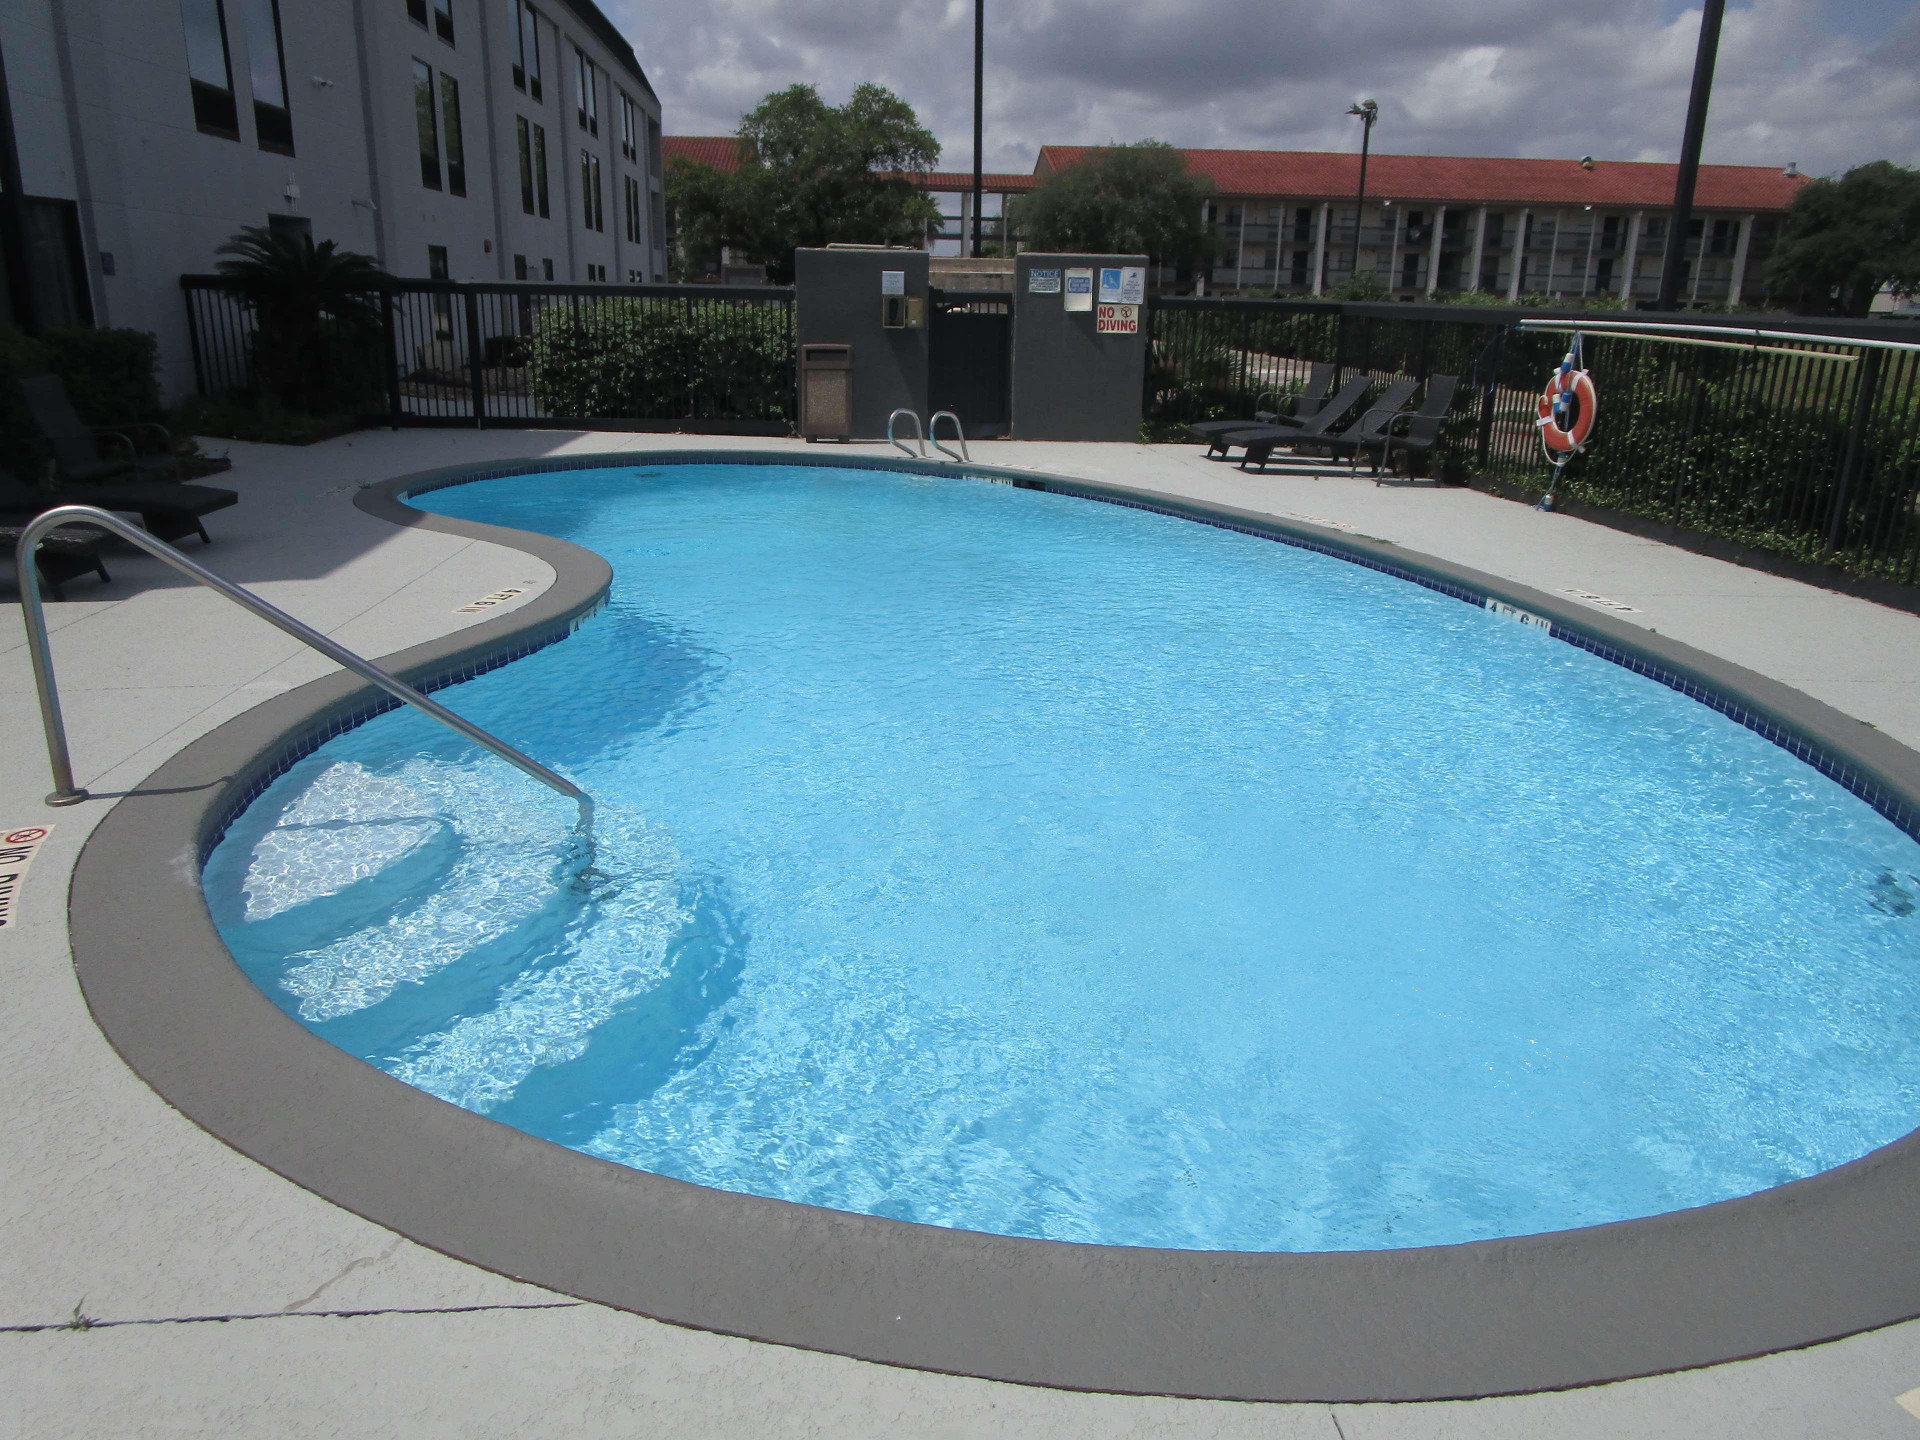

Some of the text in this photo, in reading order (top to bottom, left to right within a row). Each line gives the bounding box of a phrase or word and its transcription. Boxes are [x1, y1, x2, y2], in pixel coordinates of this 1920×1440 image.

[1031, 270, 1058, 278] NOTICE
[1099, 307, 1114, 318] NO
[1098, 320, 1136, 332] DIVING
